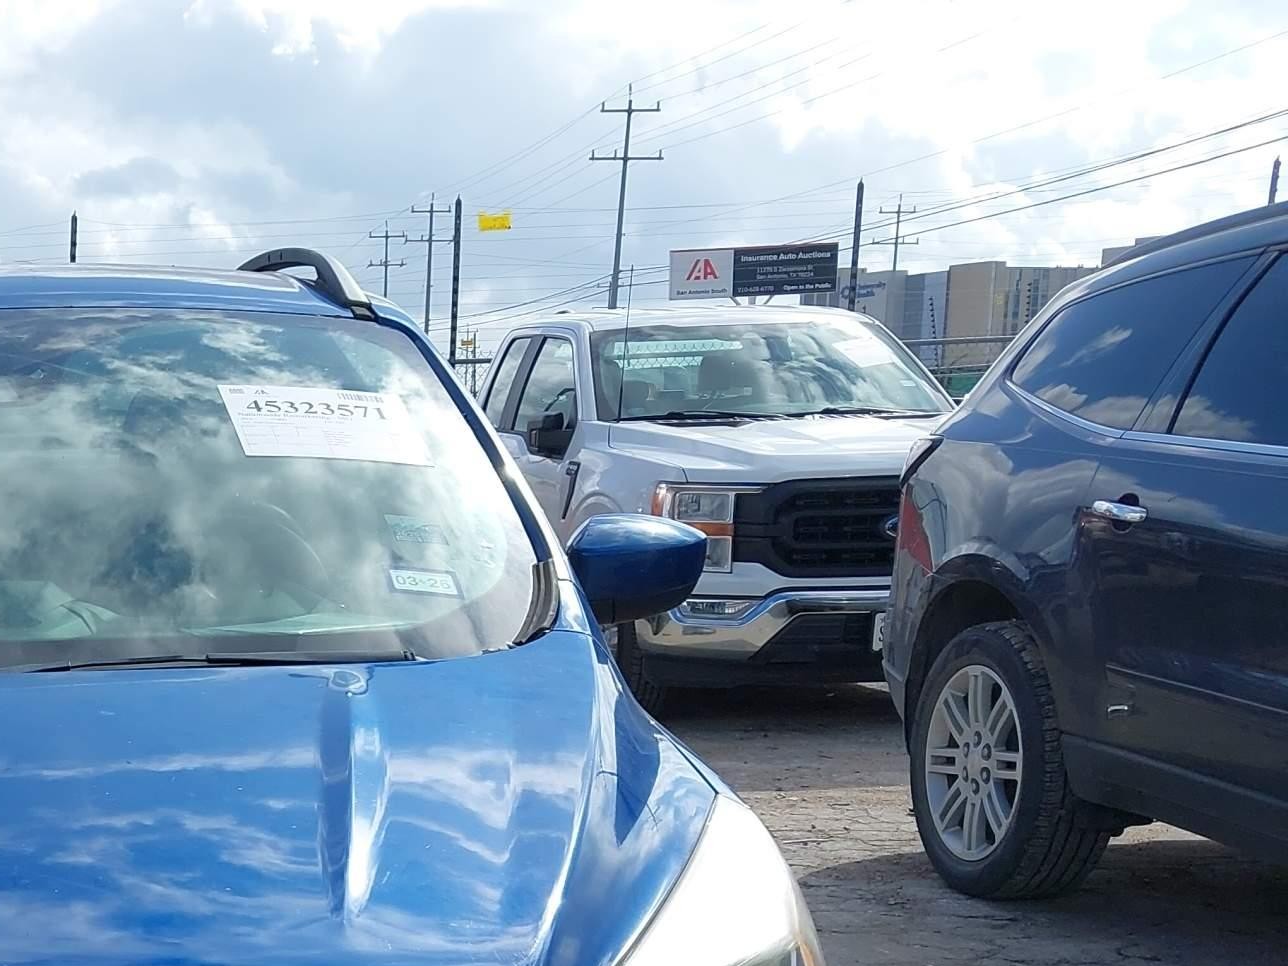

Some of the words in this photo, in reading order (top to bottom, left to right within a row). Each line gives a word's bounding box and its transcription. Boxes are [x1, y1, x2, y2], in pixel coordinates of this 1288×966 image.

[741, 254, 778, 263] Insurance
[797, 251, 831, 260] Auctions
[246, 400, 386, 420] 45323571
